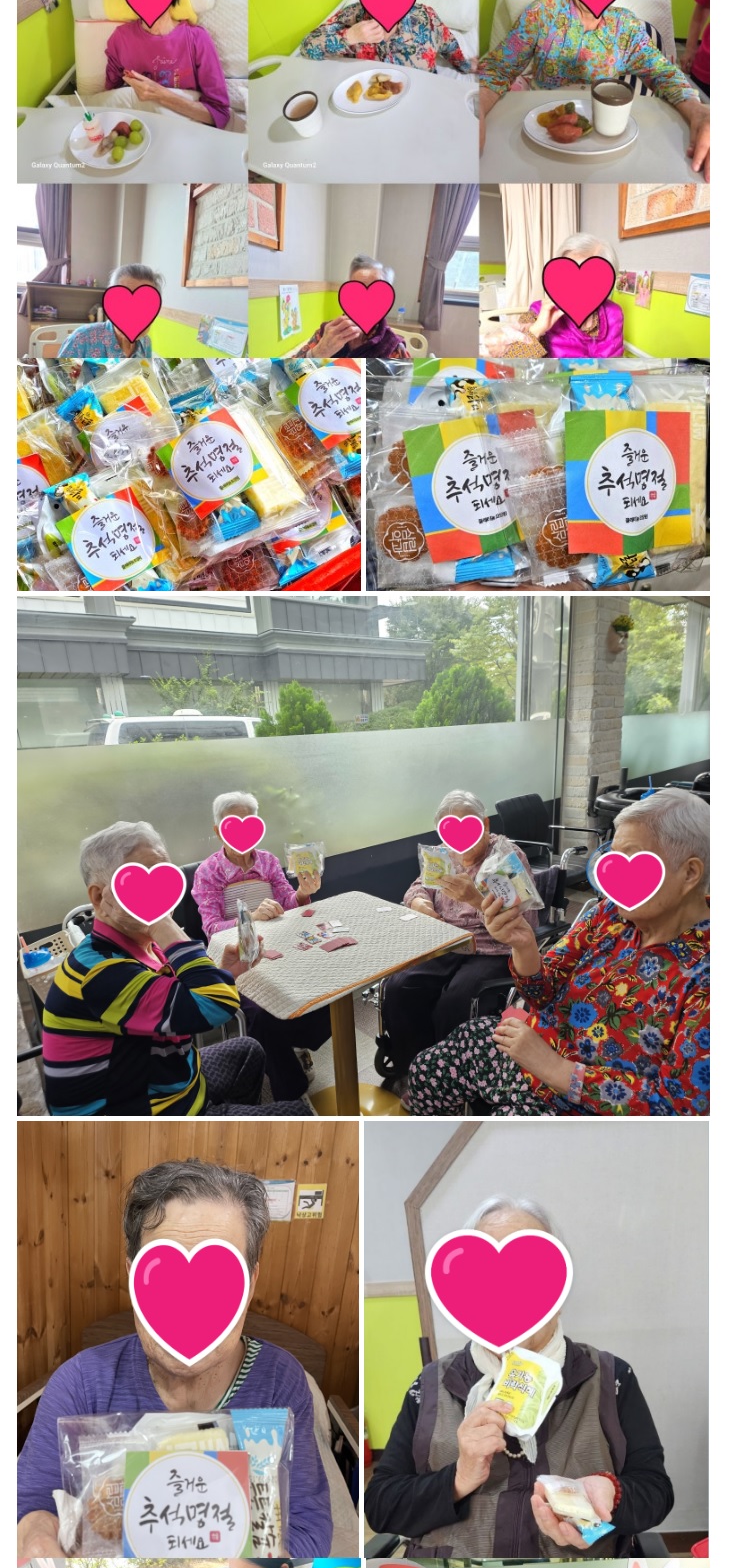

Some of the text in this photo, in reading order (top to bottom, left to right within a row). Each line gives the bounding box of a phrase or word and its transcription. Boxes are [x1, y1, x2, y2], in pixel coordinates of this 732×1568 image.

[622, 443, 650, 466] 즐거운
[598, 466, 668, 496] 추석명절
[167, 1469, 208, 1497] 즐거운
[139, 1496, 236, 1533] 추석명절
[168, 1536, 209, 1551] 되세요
